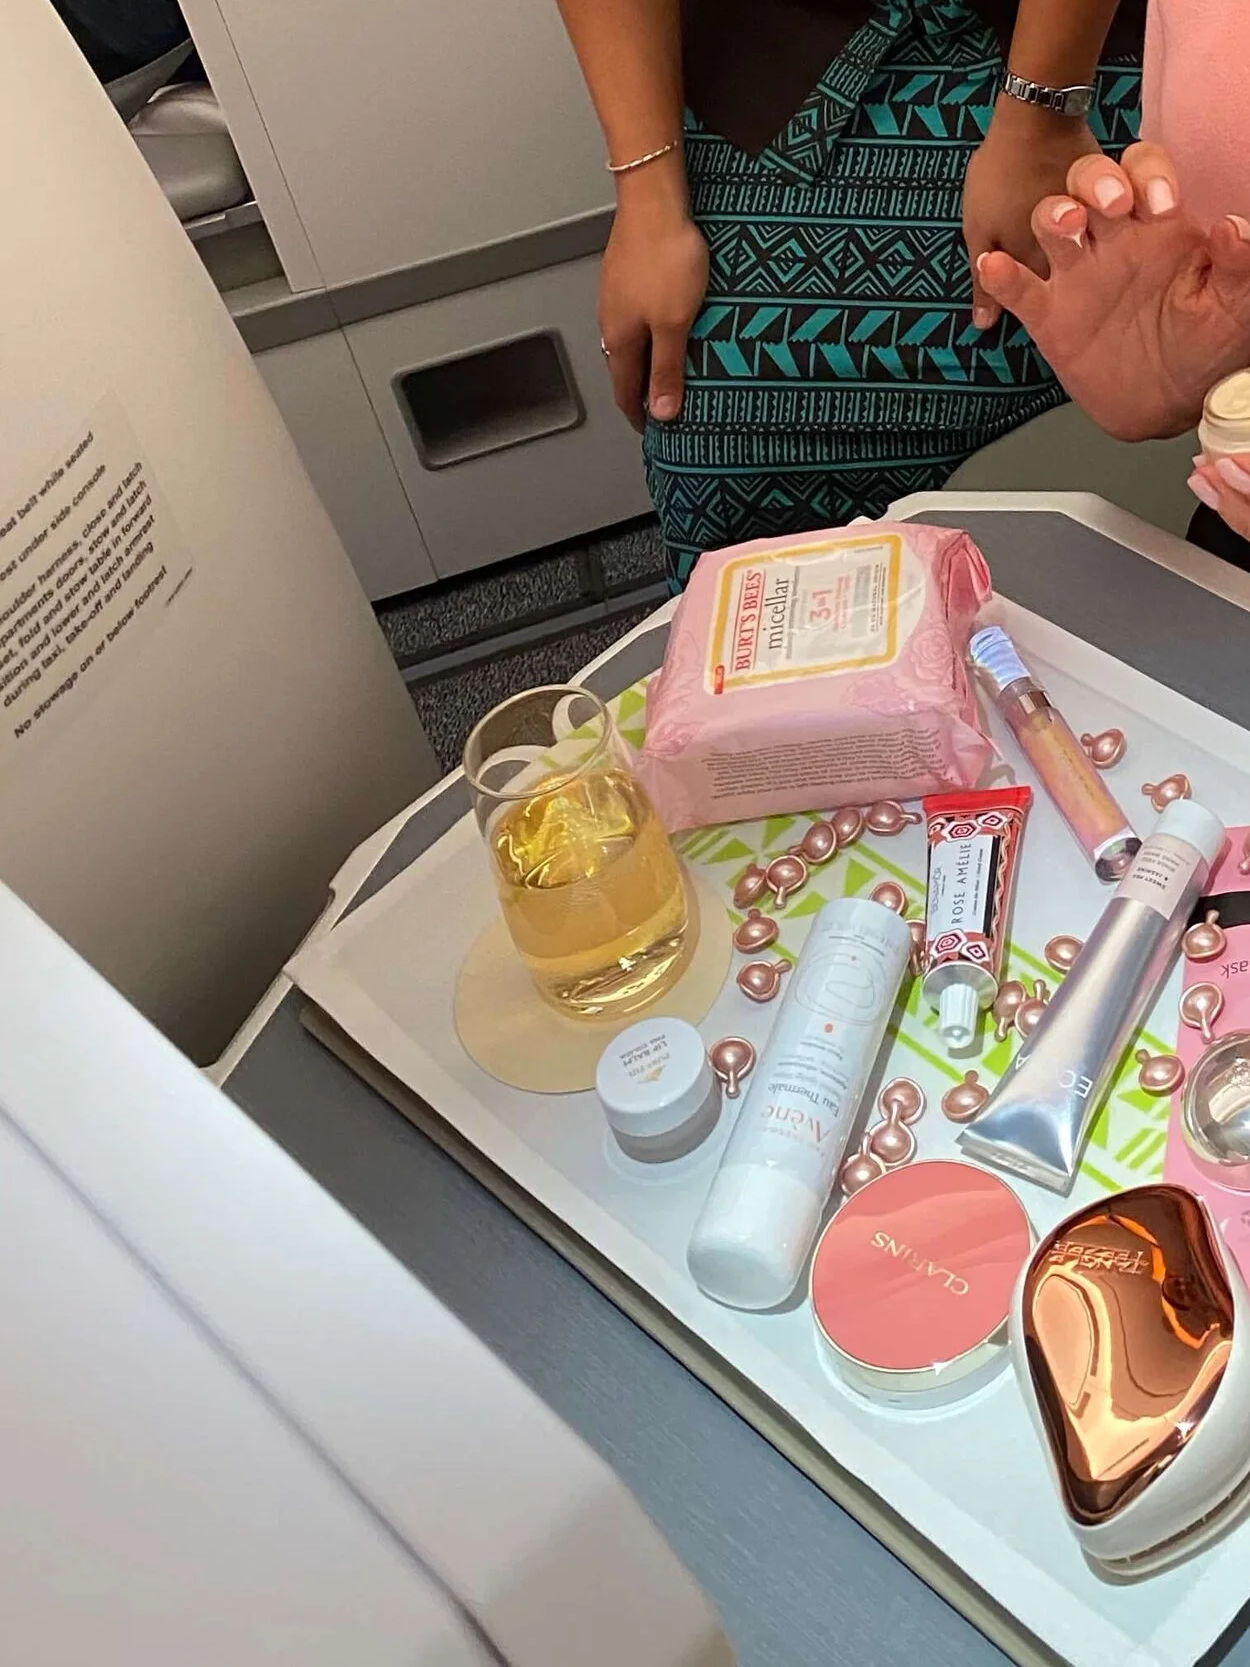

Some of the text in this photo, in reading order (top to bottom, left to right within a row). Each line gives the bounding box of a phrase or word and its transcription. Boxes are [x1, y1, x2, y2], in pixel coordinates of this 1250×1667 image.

[17, 495, 38, 519] belt
[38, 468, 64, 496] while
[65, 431, 93, 469] seated
[18, 529, 48, 562] under
[50, 506, 71, 530] side
[73, 465, 106, 507] console
[82, 509, 107, 538] close
[107, 485, 123, 509] and
[122, 462, 142, 488] latch
[88, 526, 109, 554] stow
[110, 504, 127, 528] and
[126, 481, 146, 507] latch
[18, 621, 41, 648] fold
[43, 599, 63, 625] and
[64, 574, 87, 602] stow
[88, 547, 112, 574] table
[111, 535, 122, 548] in
[121, 494, 152, 536] forward
[30, 634, 51, 660] and
[50, 605, 79, 637] lower
[81, 580, 101, 606] and
[100, 556, 124, 583] latch
[124, 515, 155, 557] armrest
[4, 668, 41, 707] during
[65, 599, 103, 644] take-off
[104, 578, 122, 603] and
[122, 542, 154, 581] landing
[14, 719, 31, 738] No
[33, 672, 78, 719] stowage
[95, 640, 105, 655] or
[106, 608, 134, 642] below
[135, 565, 167, 609] footrest
[735, 613, 756, 670] BURT'S
[764, 577, 789, 649] micellar
[950, 842, 971, 924] ROSE AMÉLIE
[767, 1083, 839, 1117] Eau Thermale
[868, 1228, 971, 1298] CLARINS
